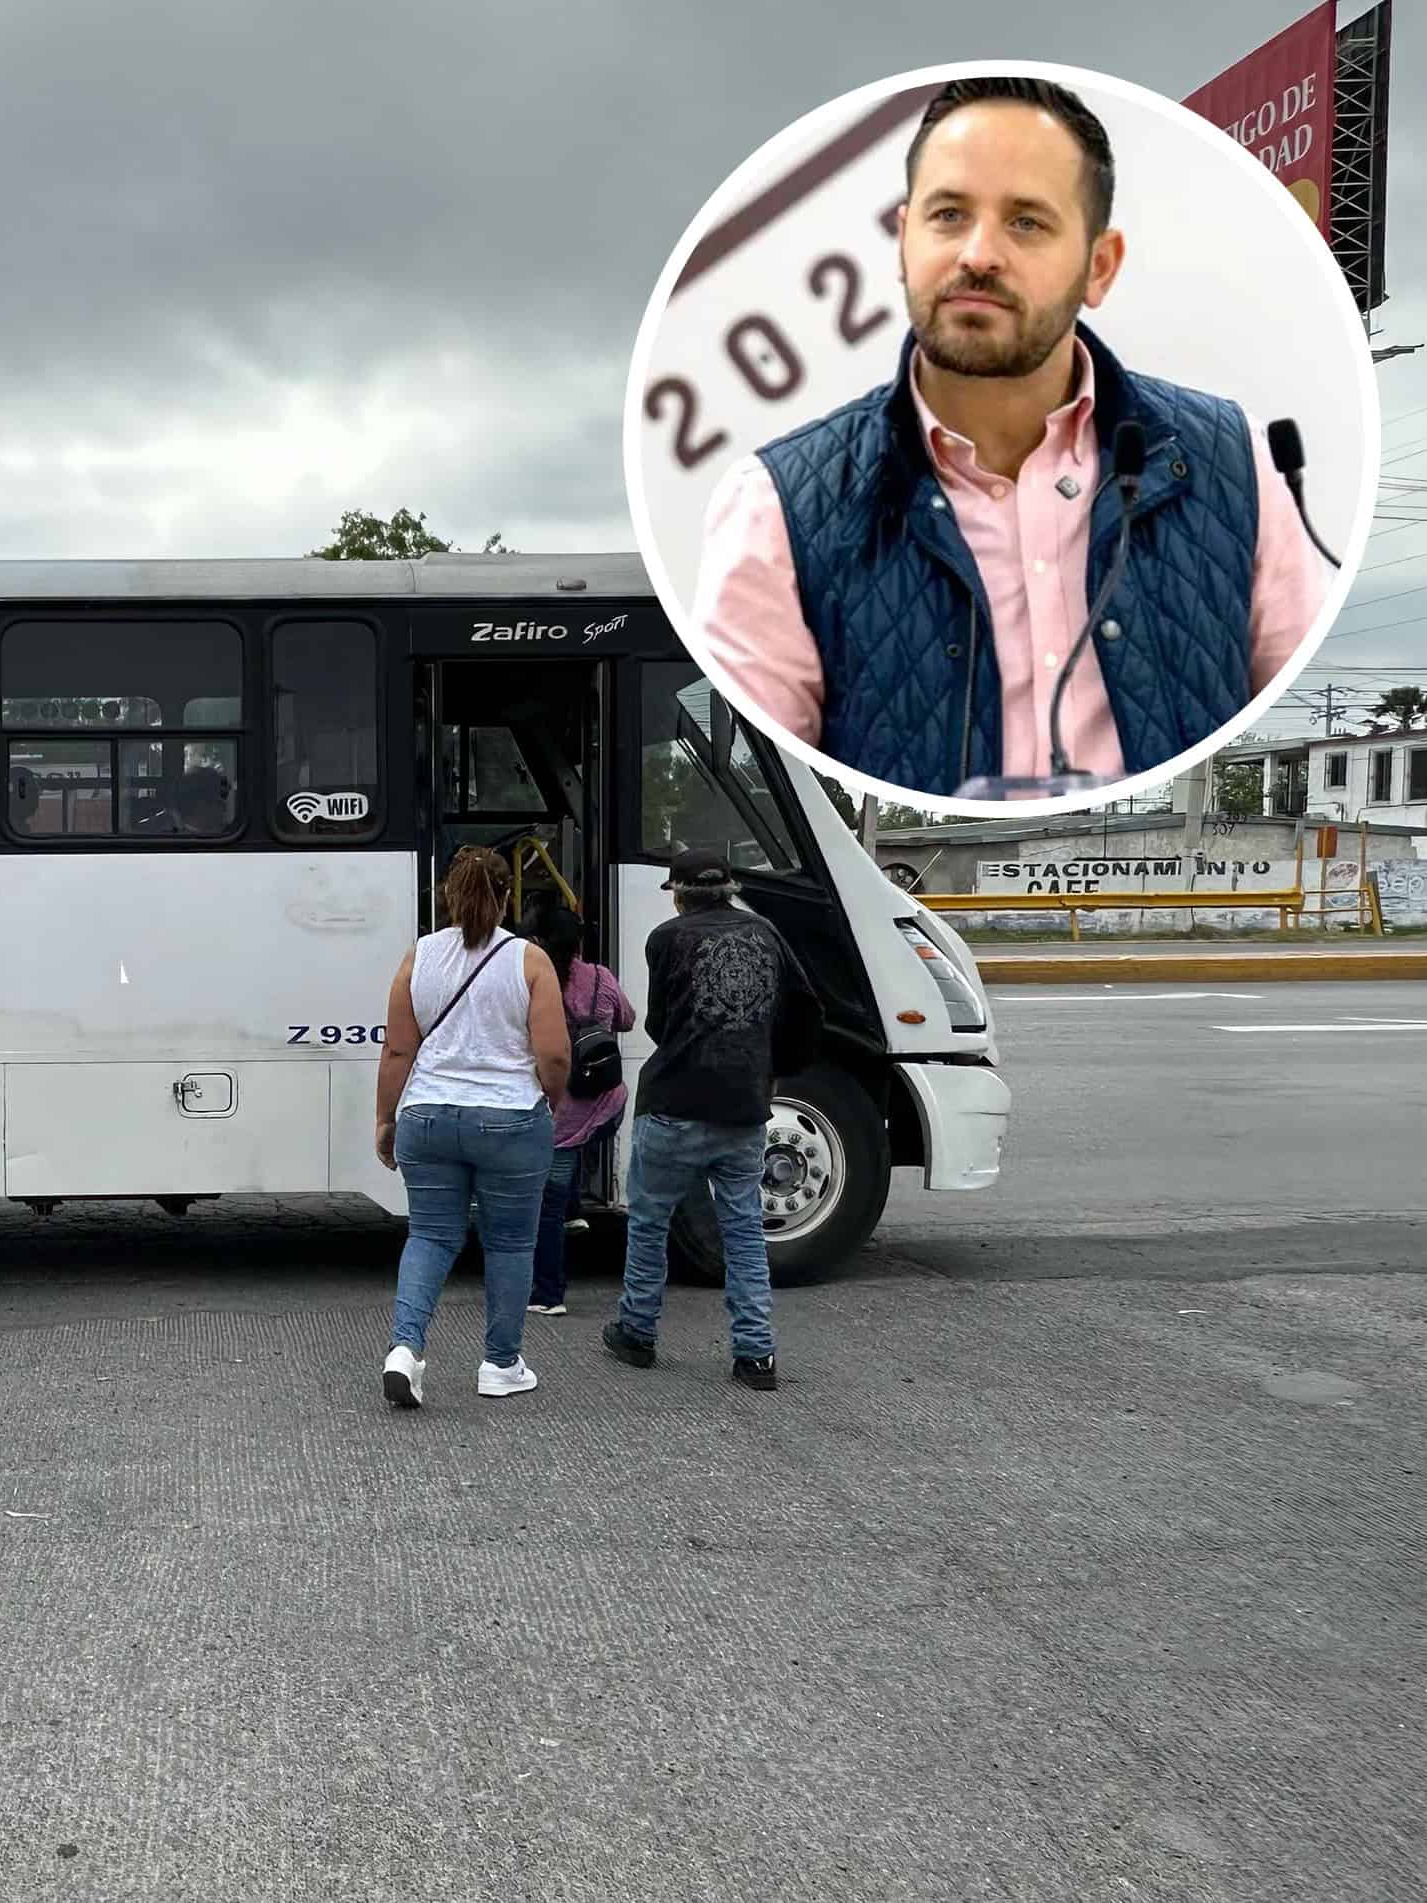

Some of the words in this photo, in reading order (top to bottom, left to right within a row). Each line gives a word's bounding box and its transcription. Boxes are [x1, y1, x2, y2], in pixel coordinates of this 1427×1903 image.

[1282, 73, 1317, 123] DE
[327, 798, 364, 816] WIFI
[286, 1025, 311, 1045] Z
